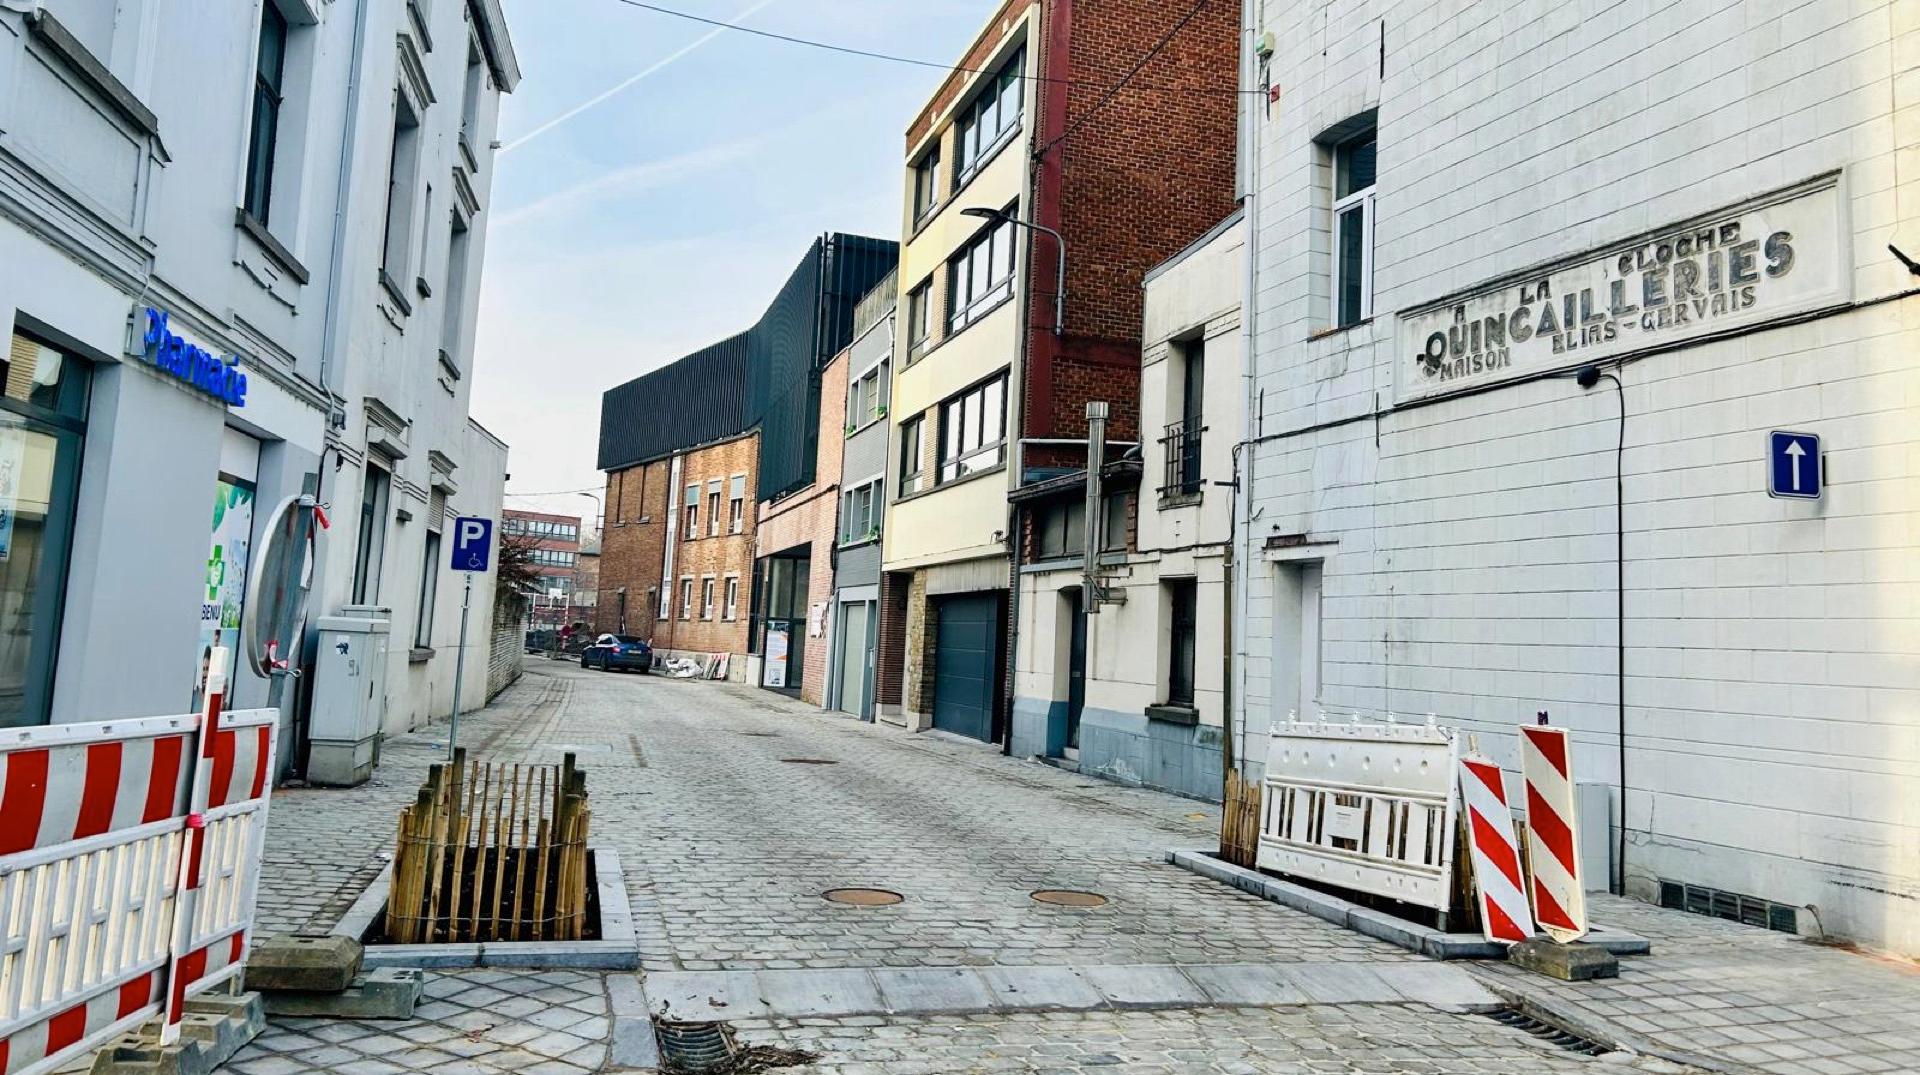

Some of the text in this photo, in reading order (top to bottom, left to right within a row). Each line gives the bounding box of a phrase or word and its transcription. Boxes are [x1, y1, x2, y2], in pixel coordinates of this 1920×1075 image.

[1425, 231, 1795, 370] QUINCAILLERIES
[1520, 281, 1551, 305] LA
[1618, 221, 1741, 277] CLOCHE
[144, 307, 247, 407] Pharmacie
[1440, 347, 1511, 382] MAISON
[461, 521, 485, 549] P
